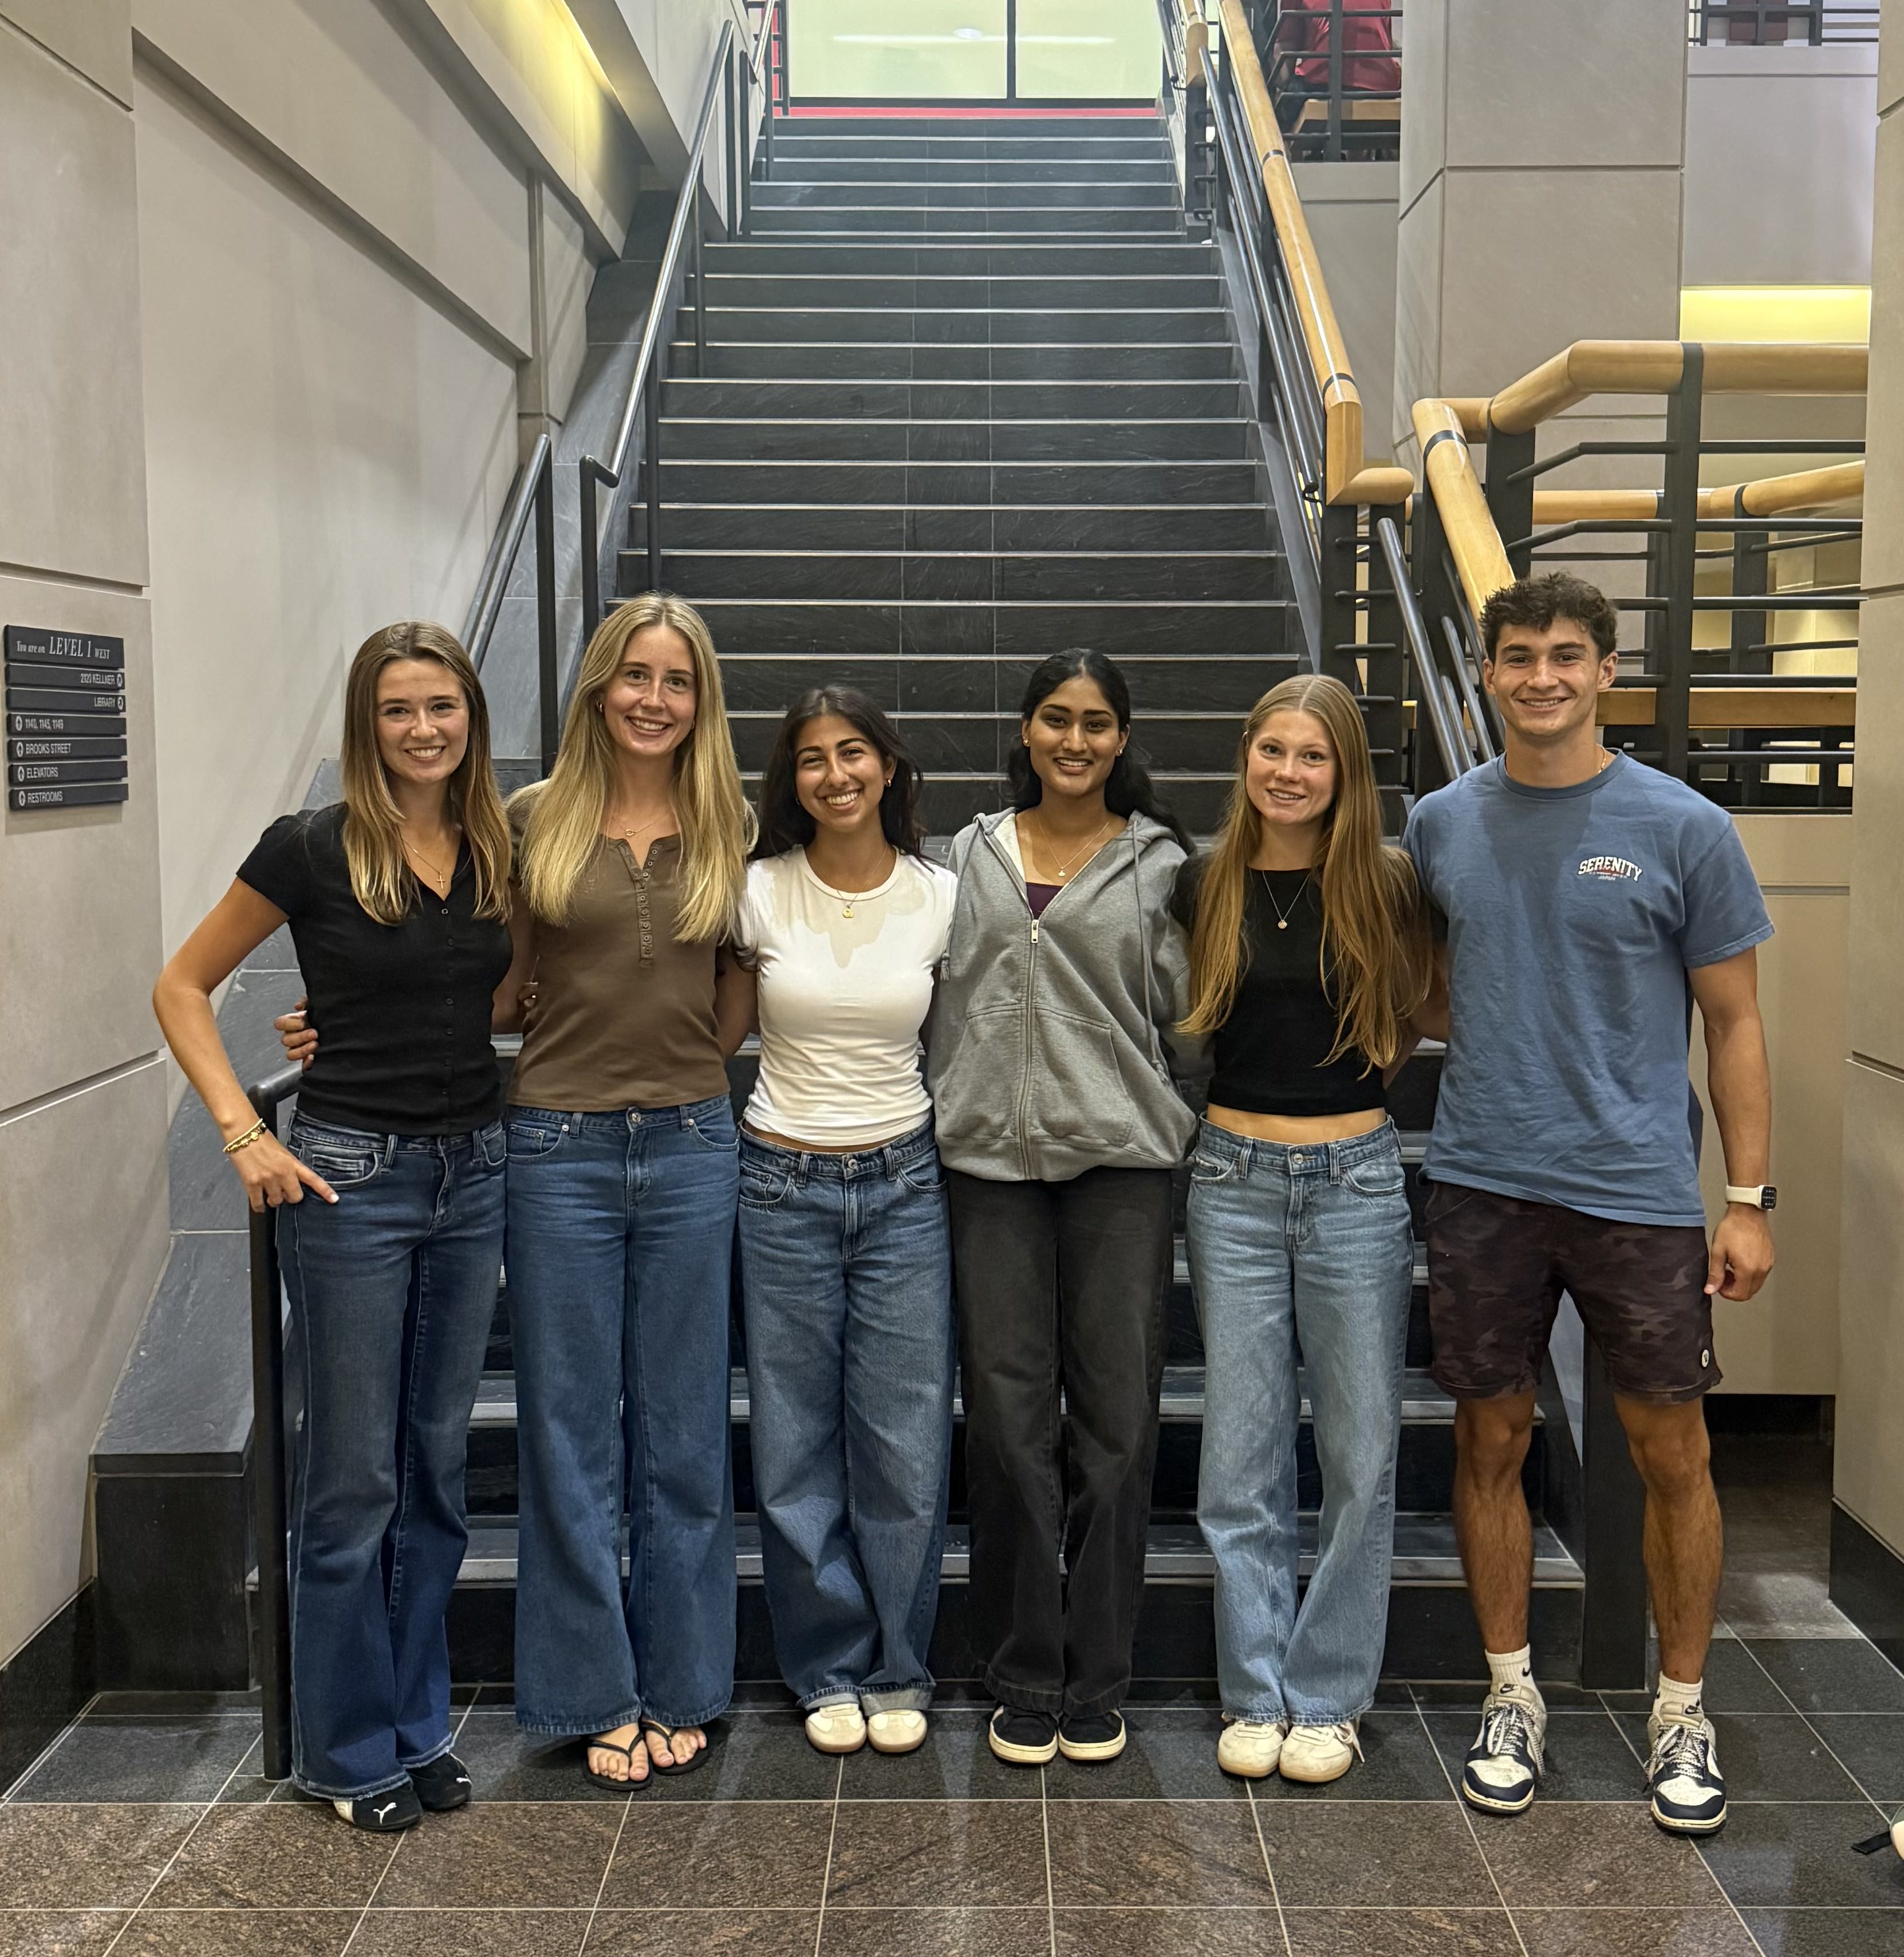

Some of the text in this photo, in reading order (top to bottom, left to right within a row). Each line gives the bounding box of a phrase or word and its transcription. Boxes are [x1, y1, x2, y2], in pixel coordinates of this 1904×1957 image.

[17, 636, 111, 659] You are on LEVEL 1 WEST
[92, 674, 115, 684] KELLNER
[94, 697, 116, 707] LIBRARY
[26, 743, 72, 754] BROOKS STREET
[26, 766, 58, 778] ELEVATORS
[27, 790, 63, 804] RESTROOMS
[1578, 856, 1642, 883] SERENITY
